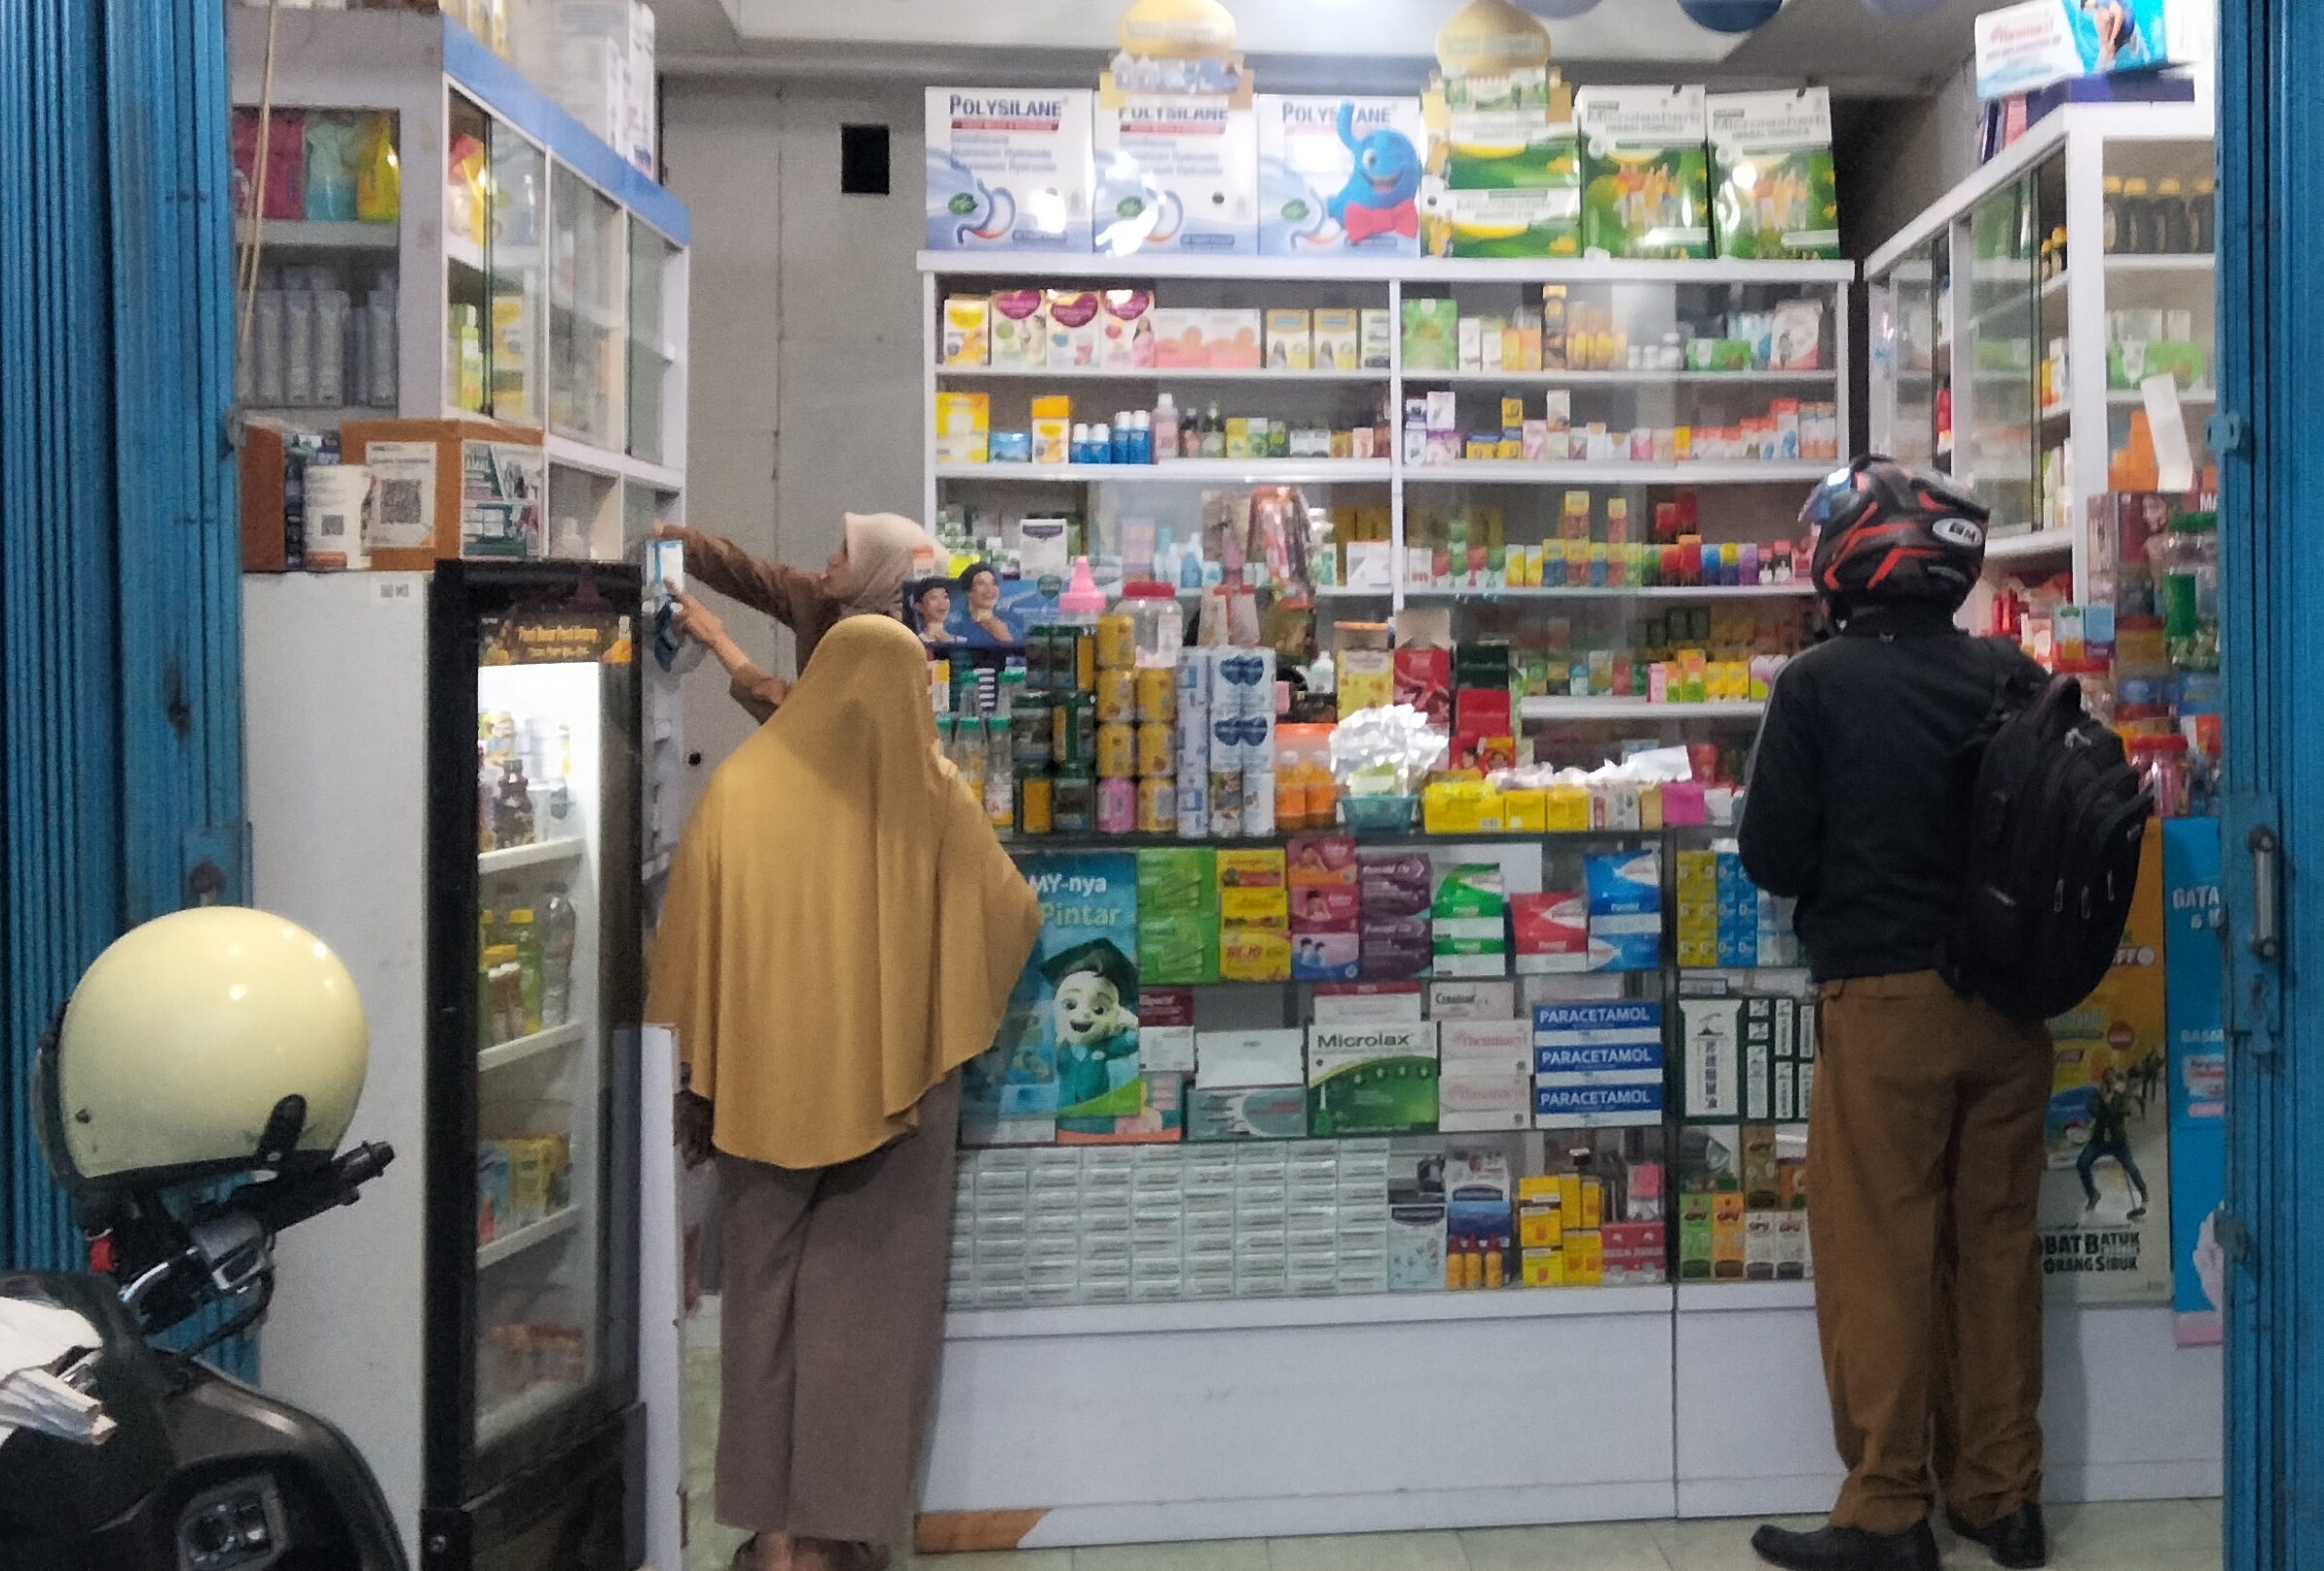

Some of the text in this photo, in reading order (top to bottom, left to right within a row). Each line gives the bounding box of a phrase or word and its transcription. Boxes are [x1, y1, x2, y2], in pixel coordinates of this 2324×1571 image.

[950, 94, 1062, 117] POLYSILANE
[1282, 101, 1390, 124] POLYSANE
[1038, 902, 1122, 927] Pintar
[1539, 1007, 1651, 1023] PARACETAMOL
[1317, 1033, 1411, 1048] Microlax
[1541, 1048, 1653, 1065] PARACETAMOL
[1540, 1089, 1652, 1106] PARACETAMOL
[2084, 1232, 2140, 1255] BATUK
[2044, 1257, 2093, 1274] ORANG
